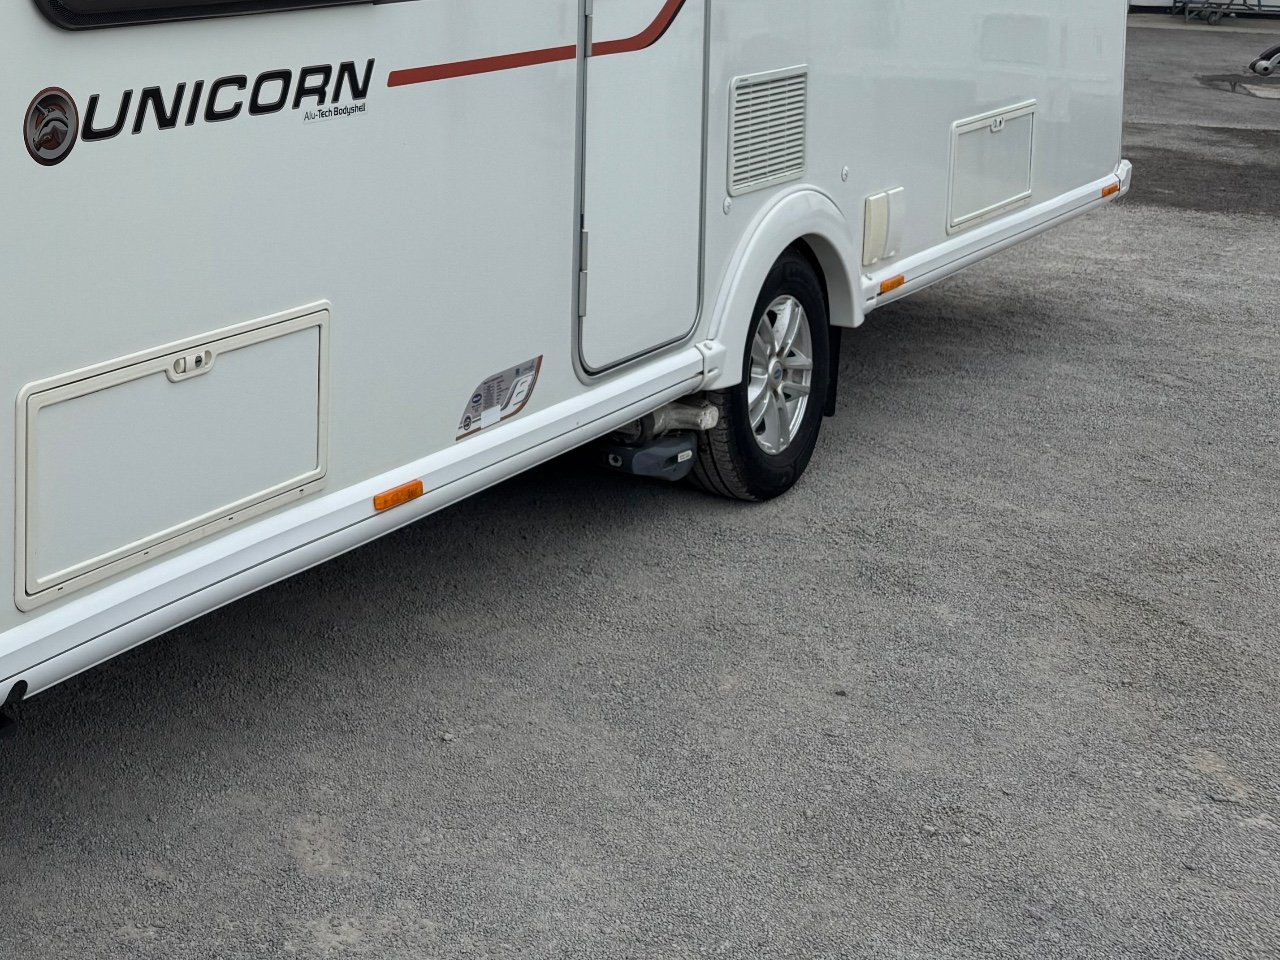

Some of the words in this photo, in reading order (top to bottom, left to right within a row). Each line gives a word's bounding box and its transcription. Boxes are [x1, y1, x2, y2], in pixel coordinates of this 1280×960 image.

[80, 58, 376, 142] UNICORN
[304, 108, 333, 121] Alu-Tech
[333, 103, 366, 117] Bodyshell
